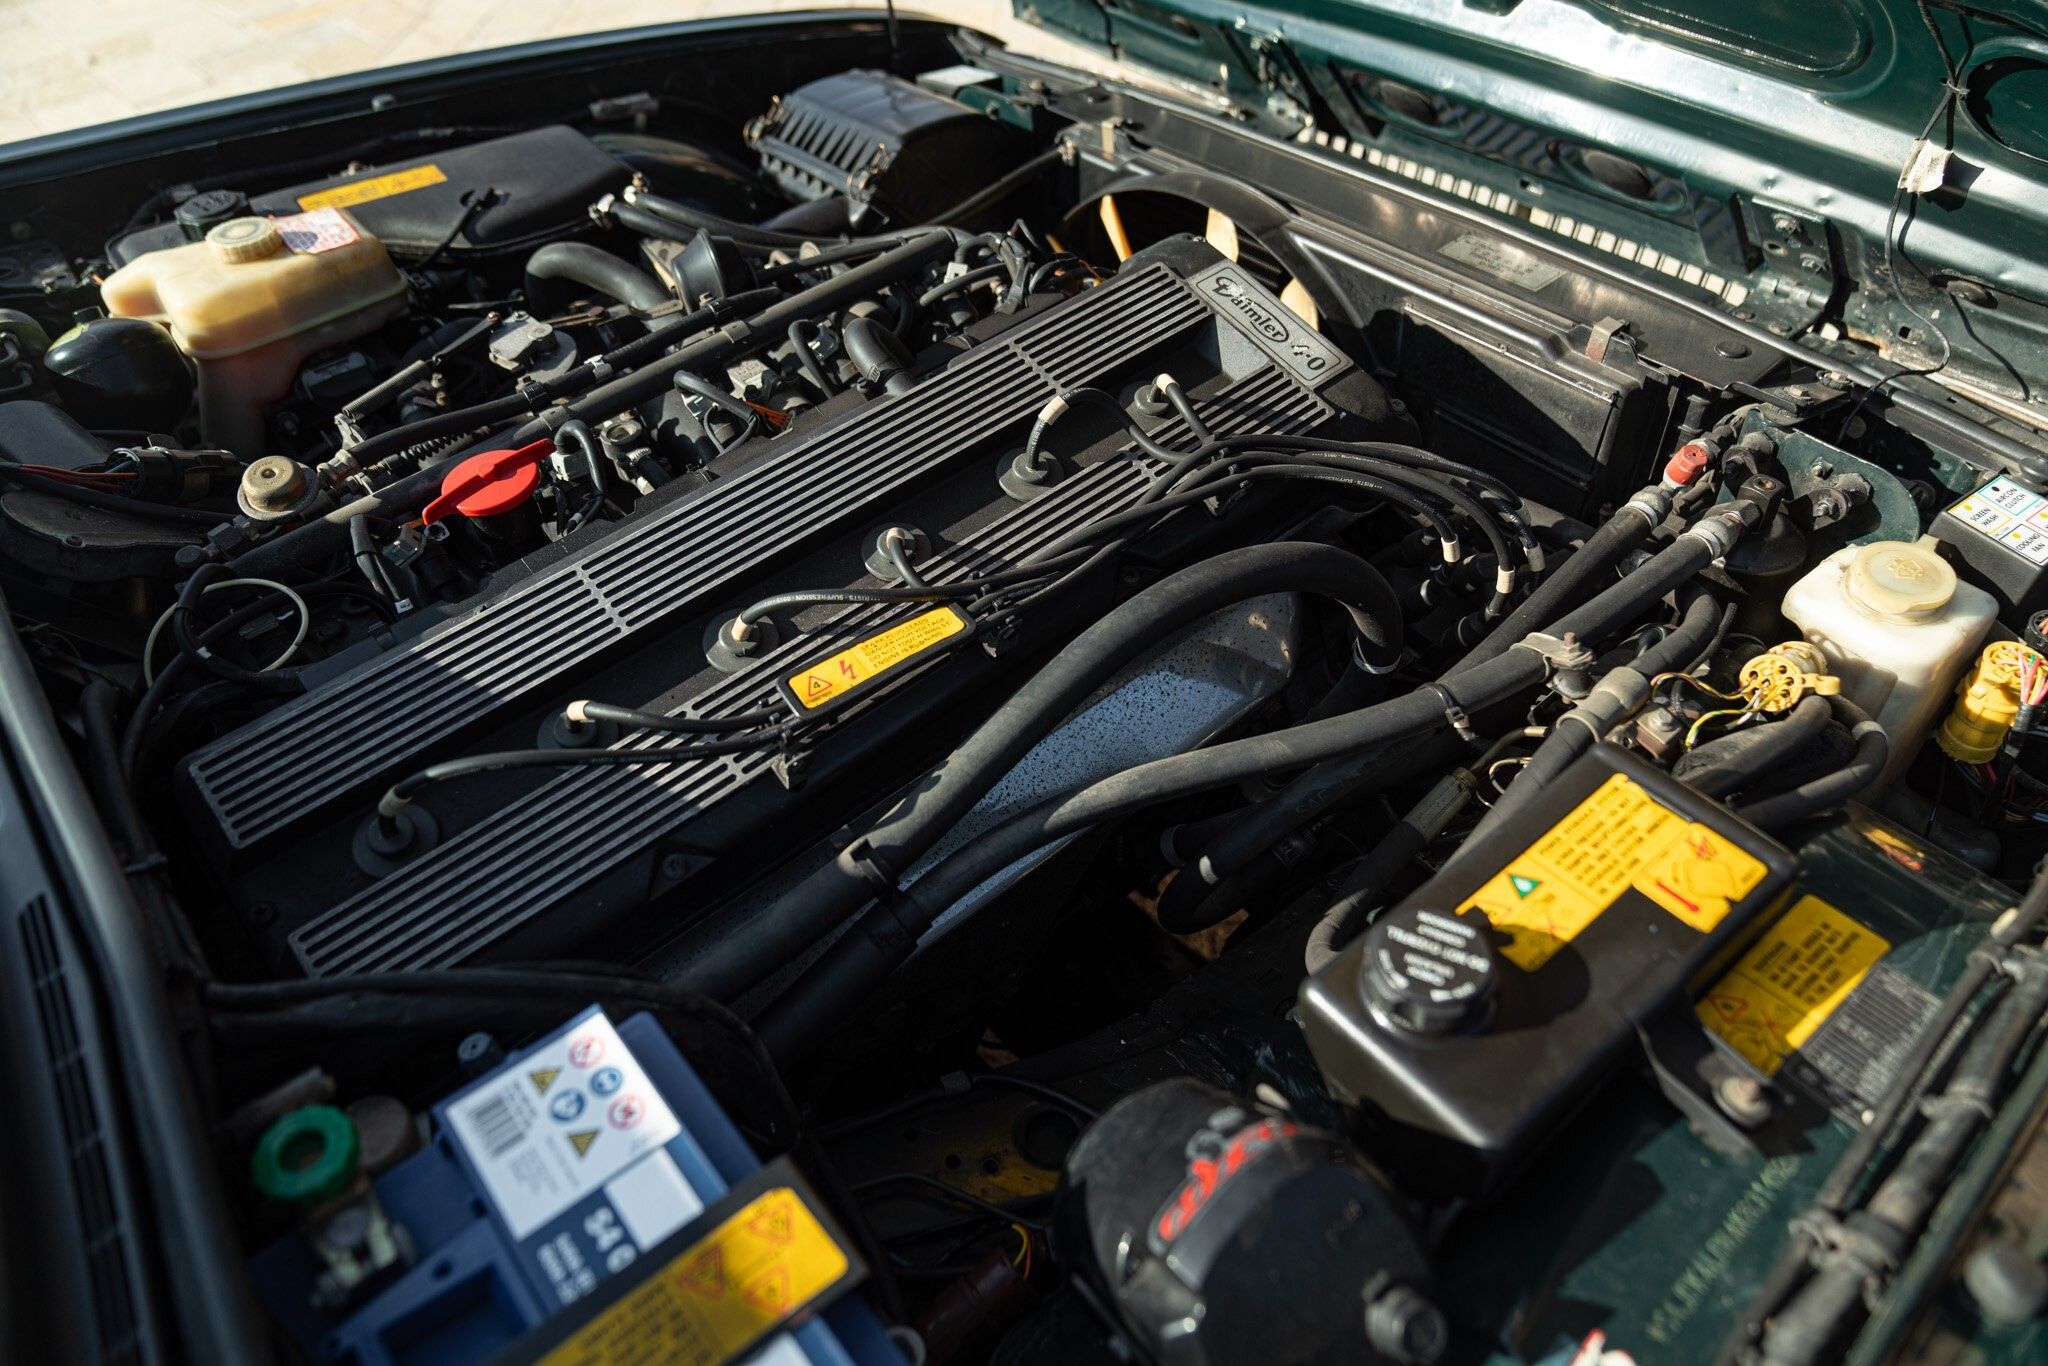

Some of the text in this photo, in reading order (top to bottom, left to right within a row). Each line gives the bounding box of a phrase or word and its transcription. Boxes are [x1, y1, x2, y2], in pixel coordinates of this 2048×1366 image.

[1212, 277, 1289, 343] Daimler
[2005, 494, 2026, 508] CLUTCH
[1970, 507, 1991, 521] SCREEN
[1981, 514, 1999, 526] WASH
[2016, 533, 2041, 550] COOLING
[2032, 543, 2046, 552] FAN
[795, 594, 844, 602] SUPPRESSION
